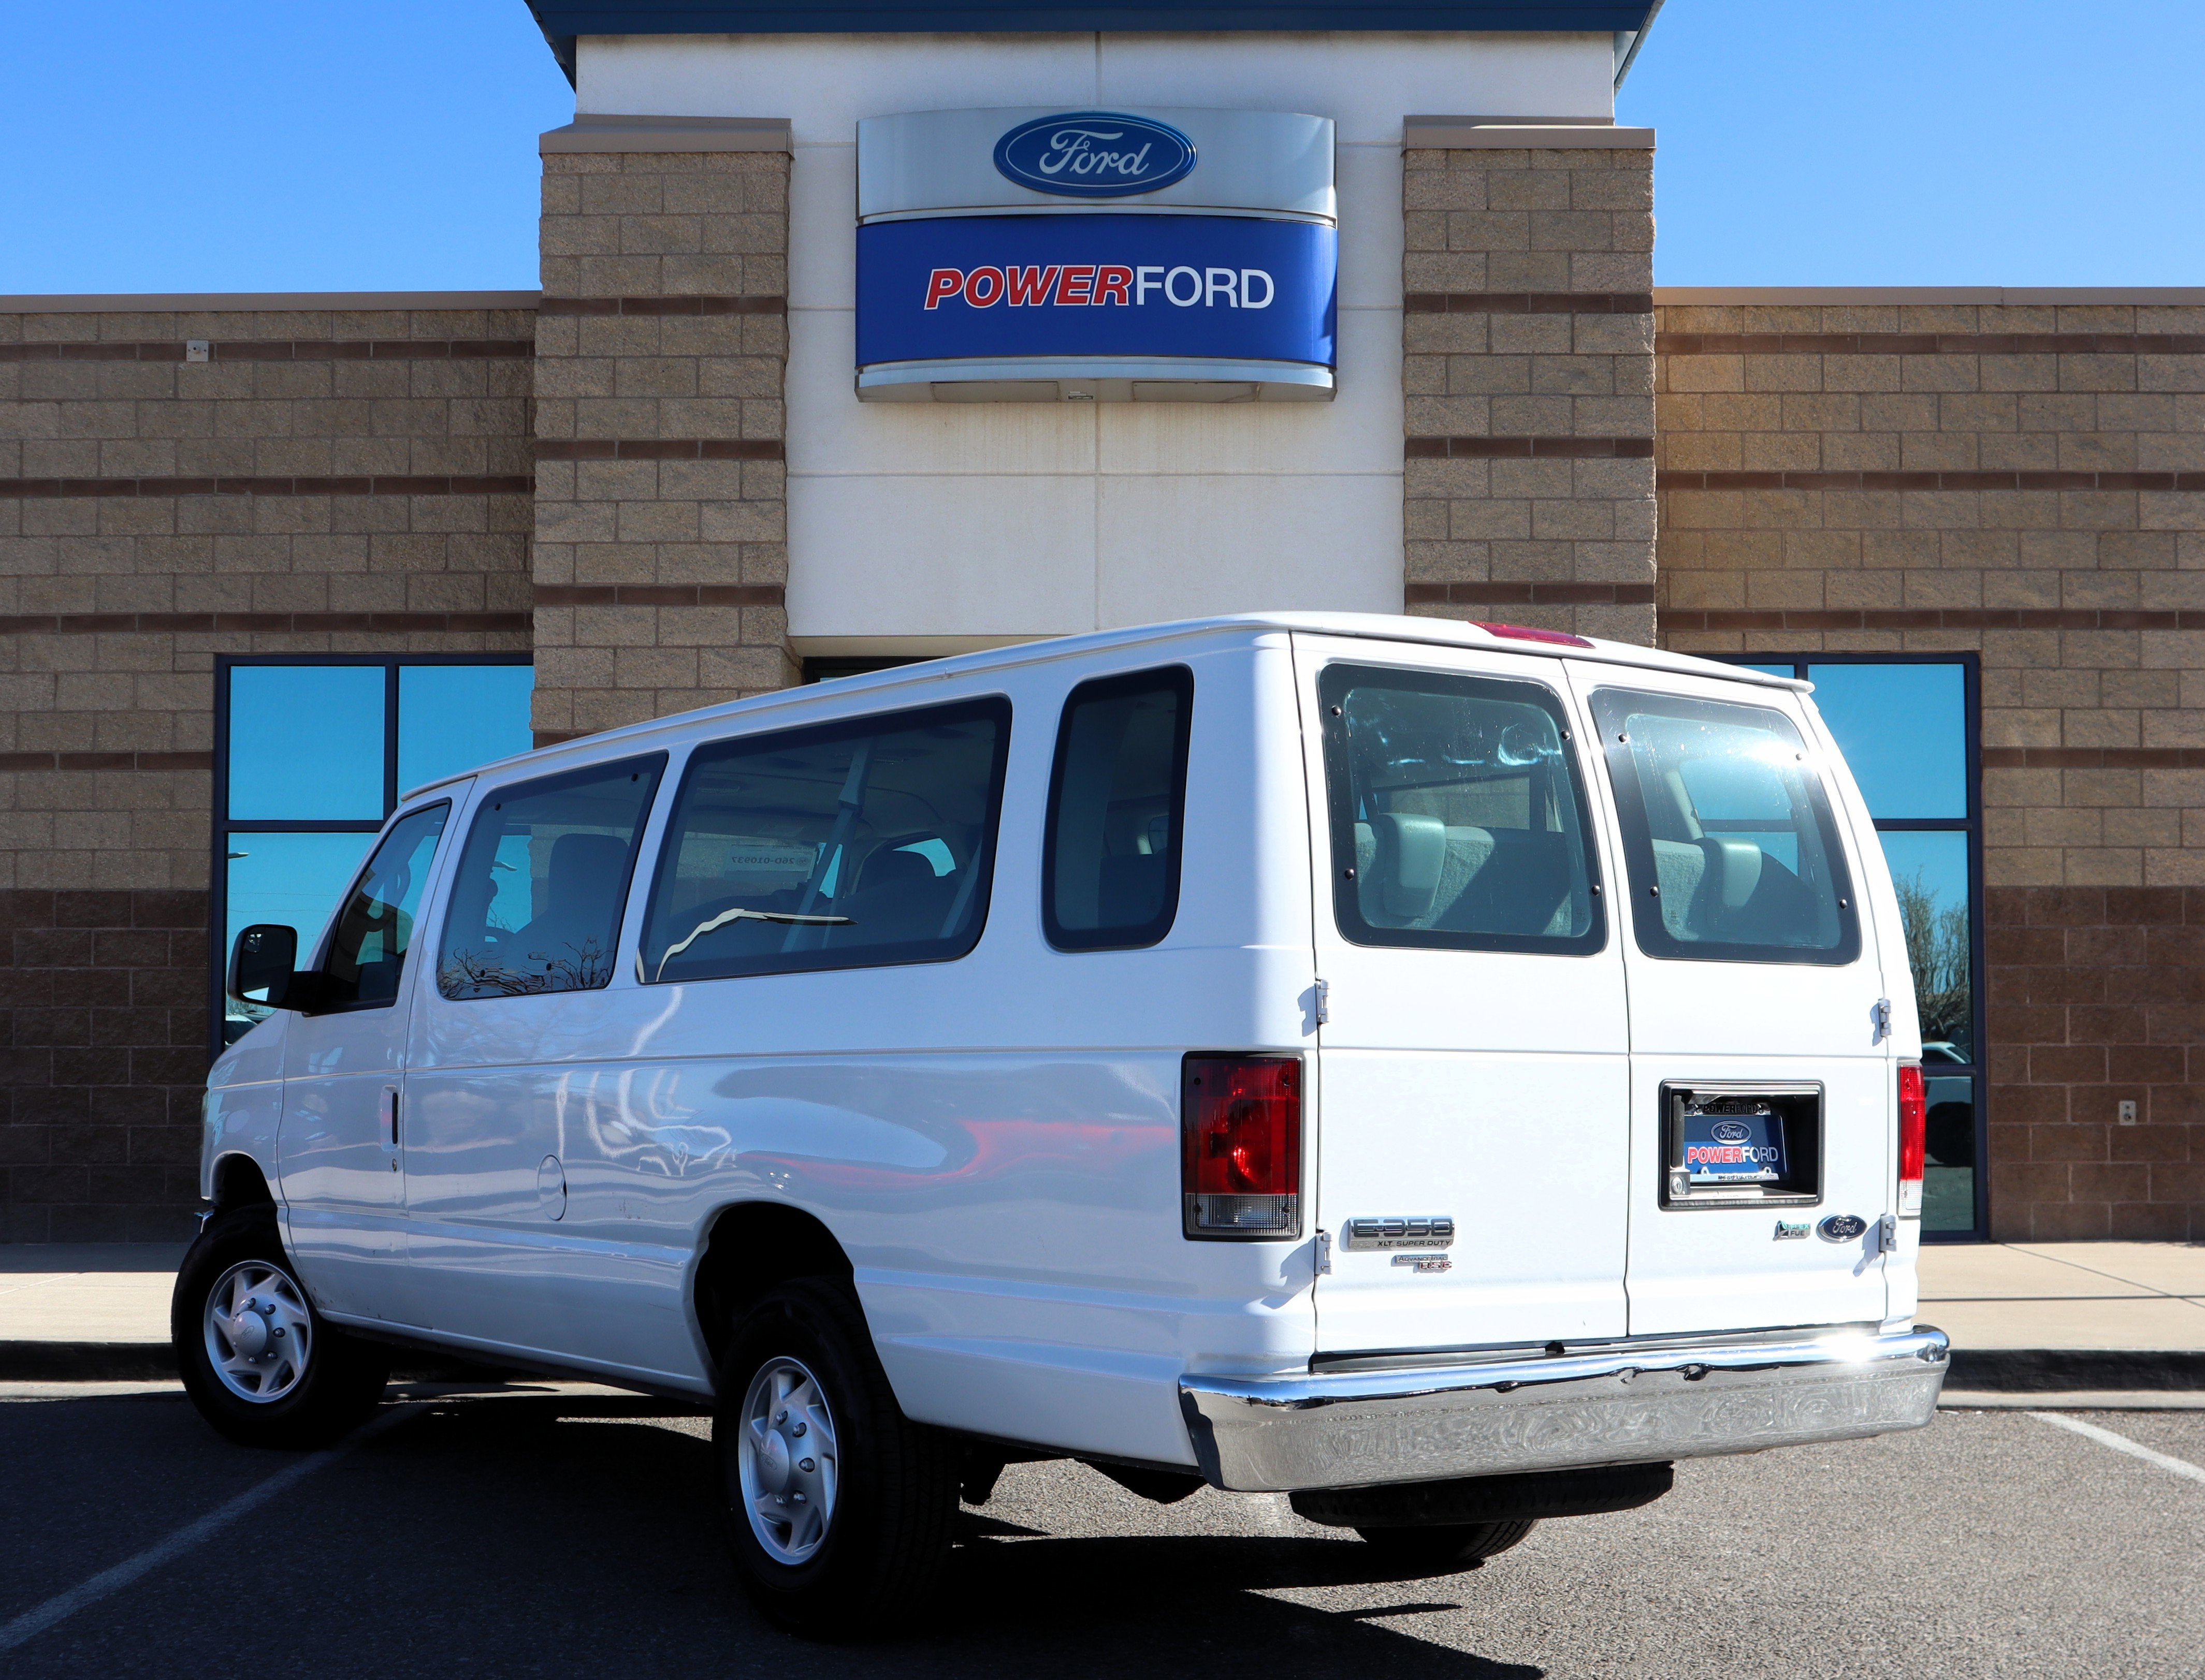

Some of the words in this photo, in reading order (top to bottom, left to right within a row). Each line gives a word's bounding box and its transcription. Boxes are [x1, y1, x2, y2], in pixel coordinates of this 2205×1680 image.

[1039, 129, 1152, 177] Ford
[1719, 1124, 1744, 1139] Ford
[1832, 1218, 1858, 1234] Ford
[1419, 1261, 1452, 1269] RSC
